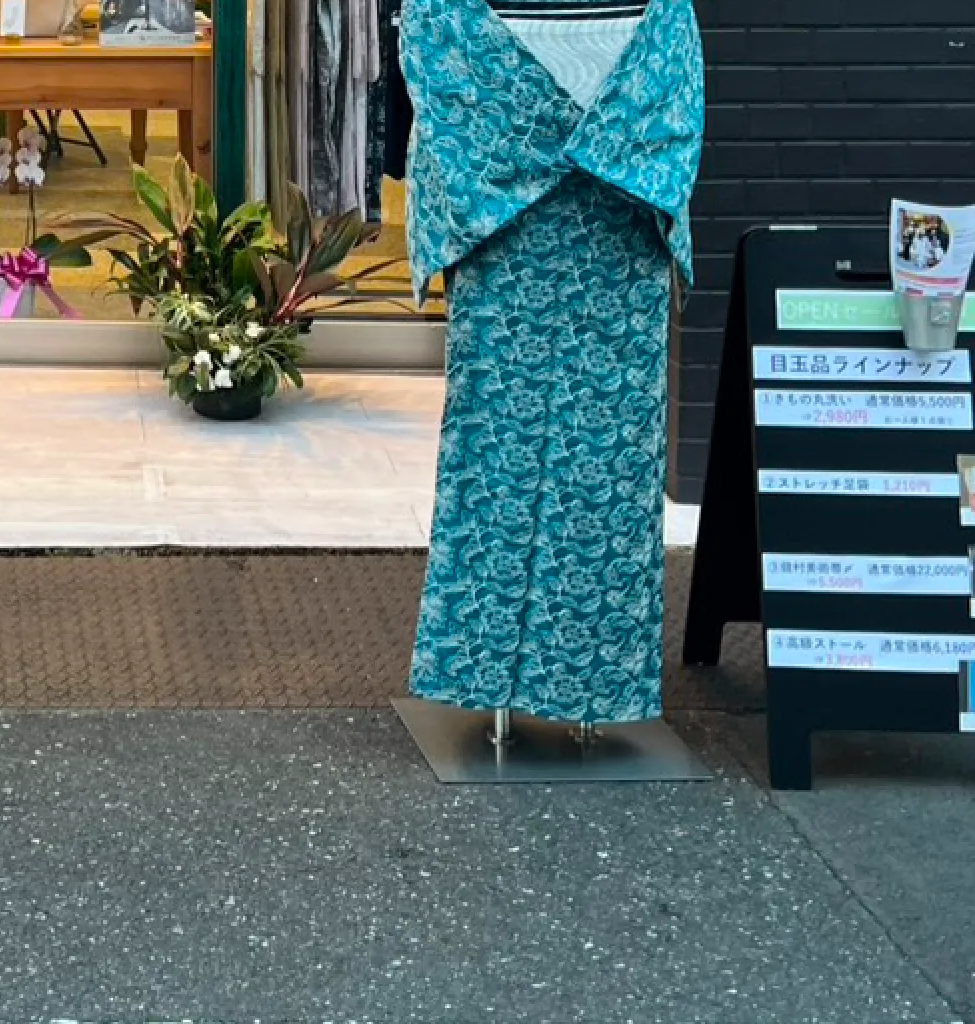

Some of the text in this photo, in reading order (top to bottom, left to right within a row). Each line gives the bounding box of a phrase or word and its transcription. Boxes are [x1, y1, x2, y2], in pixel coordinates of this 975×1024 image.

[769, 353, 956, 376] 目玉品ラインナップ
